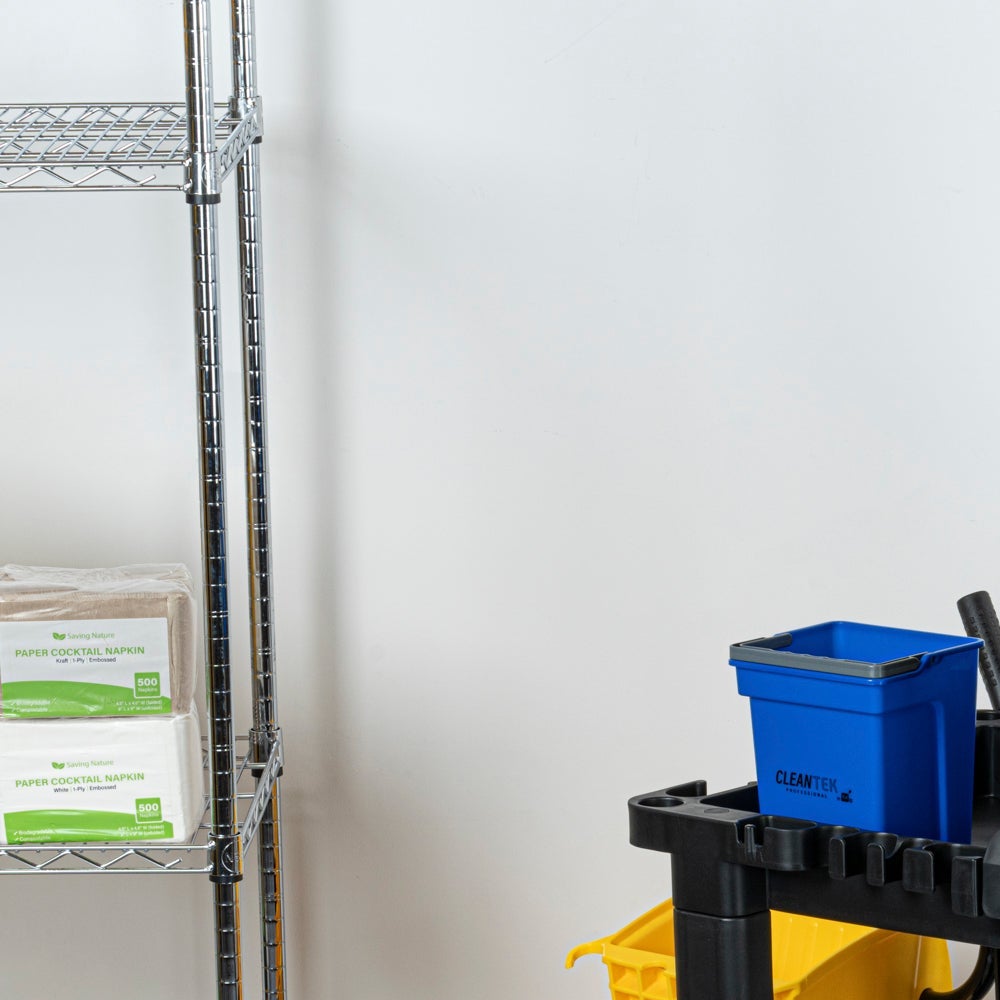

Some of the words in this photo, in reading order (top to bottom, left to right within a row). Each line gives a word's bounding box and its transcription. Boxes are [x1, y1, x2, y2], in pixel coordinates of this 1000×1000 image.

[16, 649, 48, 657] PAPER
[51, 647, 102, 656] COCKTAIL
[106, 646, 144, 655] NAPKIN
[138, 678, 158, 686] 500
[16, 778, 48, 788] PAPER
[51, 776, 102, 786] COCKTAIL
[106, 772, 144, 782] NAPKIN
[776, 770, 838, 793] CLEANTEK
[138, 803, 159, 812] 500
